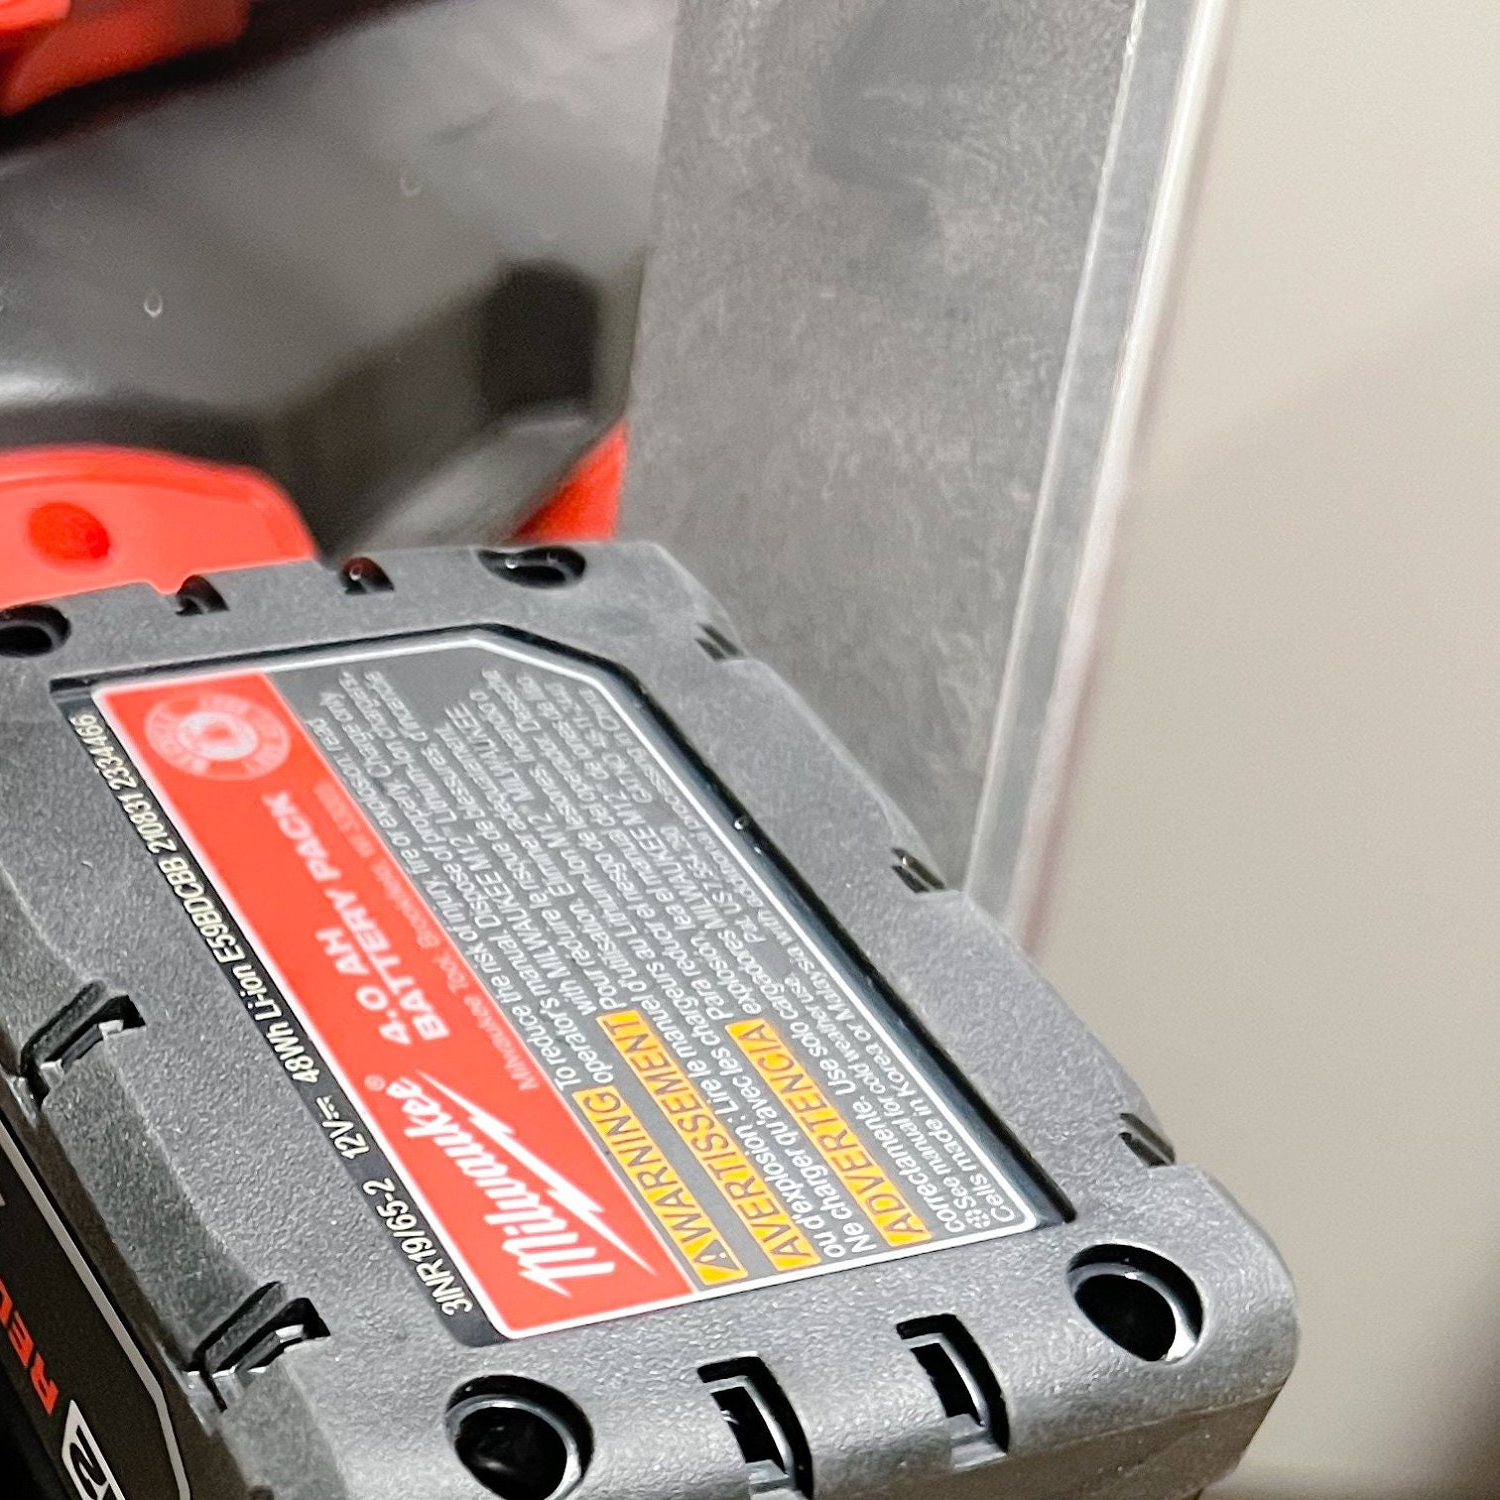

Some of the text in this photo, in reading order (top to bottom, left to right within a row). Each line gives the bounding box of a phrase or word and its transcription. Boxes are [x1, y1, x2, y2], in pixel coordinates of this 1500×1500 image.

[66, 713, 139, 790] 2334466
[442, 703, 535, 802] MILWAUKEE
[116, 791, 178, 854] 210831
[385, 829, 413, 847] or
[467, 819, 502, 841] de
[579, 801, 617, 827] del
[570, 830, 606, 853] de
[599, 828, 662, 886] manual
[436, 861, 506, 929] Dispose
[521, 891, 552, 908] le
[587, 850, 649, 902] riesgo
[628, 825, 727, 930] MILWAUKEE
[644, 886, 675, 904] el
[259, 791, 452, 1041] BATTERY PACK
[446, 922, 480, 942] of
[474, 870, 572, 979] MILWAUKEE
[625, 902, 658, 920] el
[658, 903, 696, 931] lea
[750, 907, 796, 946] with
[460, 941, 503, 974] risk
[484, 929, 551, 997] manual.
[625, 936, 656, 959] au
[638, 918, 702, 977] reducir
[225, 964, 283, 1020] Li-ion
[312, 926, 418, 1048] 4.0 AH
[483, 974, 524, 1003] the
[552, 977, 599, 1016] with
[578, 968, 628, 1010] Pour
[684, 978, 735, 1020] Para
[710, 927, 806, 1021] cargadores
[780, 945, 859, 1021] Malaysia
[629, 993, 698, 1059] manuel
[637, 958, 728, 1047] chargeurs
[261, 1021, 325, 1085] 48Wh
[456, 995, 541, 1091] Milwaukee
[504, 1004, 567, 1066] reduce
[532, 995, 620, 1085] operator's
[783, 1020, 830, 1058] solo
[801, 1003, 862, 1062] weather
[848, 1022, 874, 1042] or
[546, 1065, 585, 1090] To
[679, 1059, 712, 1077] le
[703, 1046, 744, 1075] les
[812, 1058, 859, 1095] Use
[846, 1061, 889, 1095] cold
[860, 1043, 917, 1096] Korea
[692, 1077, 740, 1114] Lire
[722, 1072, 804, 1148] qu'avec
[872, 1094, 906, 1117] for
[904, 1098, 932, 1116] in
[601, 1013, 812, 1264] AVERTISSEMENT
[732, 1023, 924, 1239] ADVERTENCIA
[890, 1117, 951, 1175] manual
[919, 1118, 977, 1172] made
[578, 1089, 716, 1243] WARNING
[776, 1145, 859, 1222] charger
[843, 1095, 968, 1234] correctamente.
[936, 1174, 979, 1209] See
[963, 1173, 1018, 1222] Cells
[360, 1176, 474, 1316] 3INR19/65-2
[811, 1230, 849, 1259] ou
[832, 1220, 877, 1254] Ne
